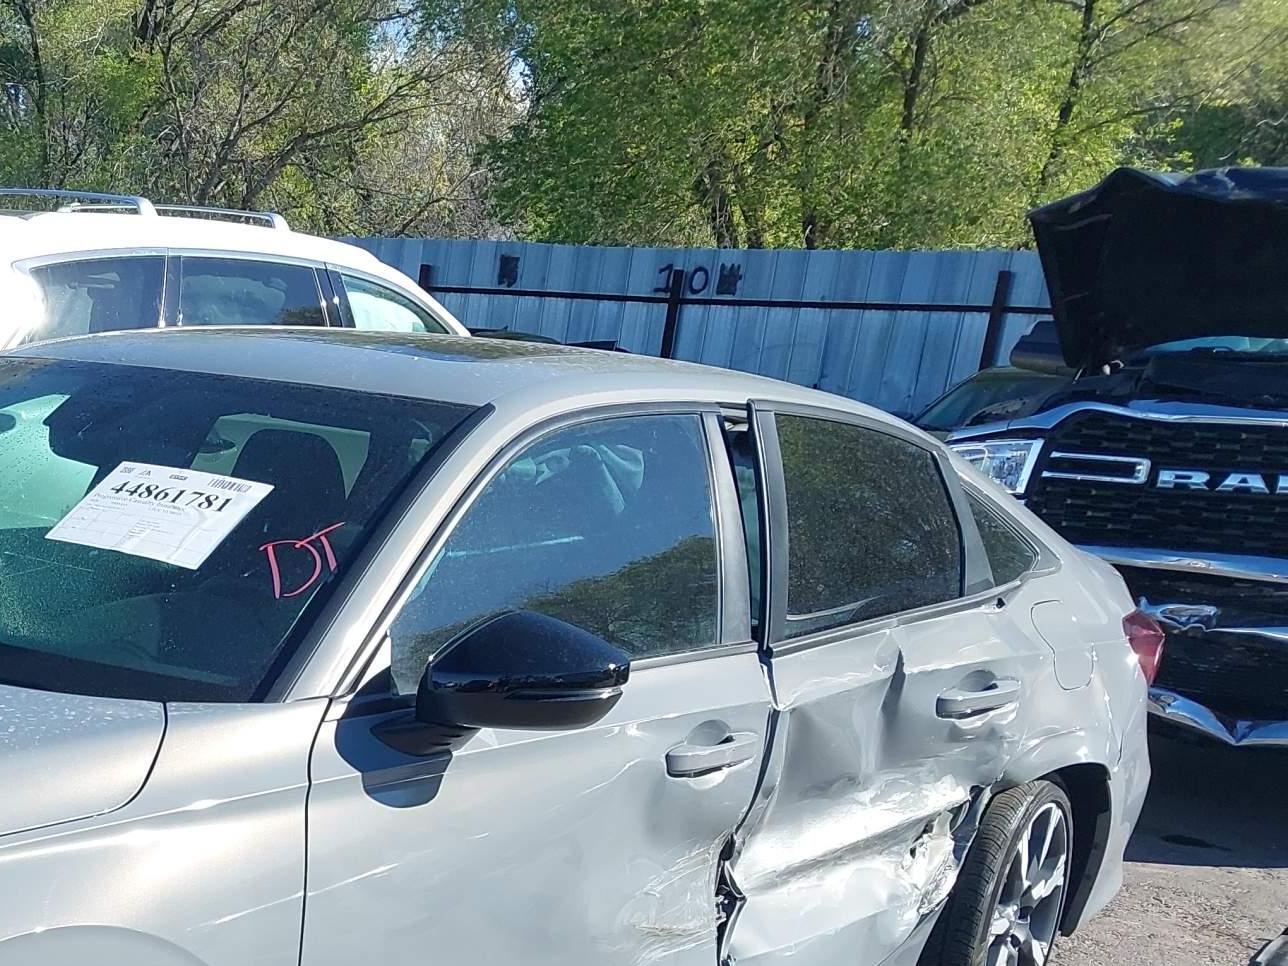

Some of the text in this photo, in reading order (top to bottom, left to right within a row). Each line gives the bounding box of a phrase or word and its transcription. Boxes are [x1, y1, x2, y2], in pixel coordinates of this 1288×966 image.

[654, 263, 710, 295] 10
[110, 480, 234, 513] 44861781
[1157, 469, 1288, 494] RA
[259, 521, 346, 599] DT
